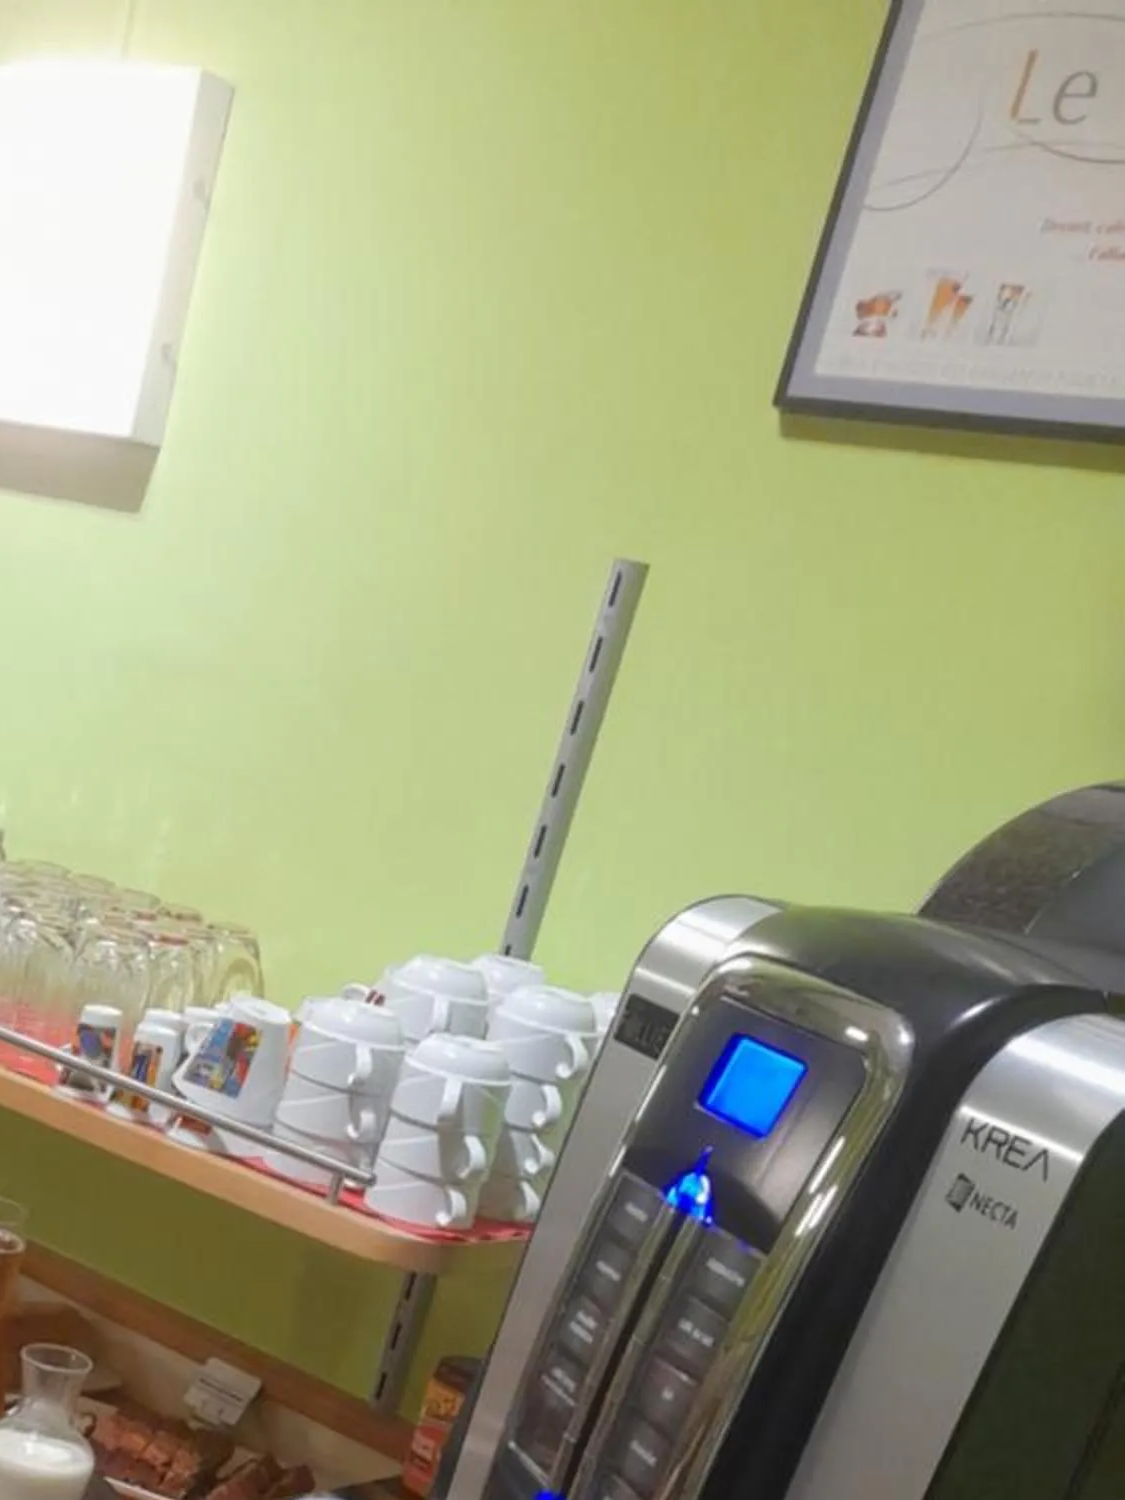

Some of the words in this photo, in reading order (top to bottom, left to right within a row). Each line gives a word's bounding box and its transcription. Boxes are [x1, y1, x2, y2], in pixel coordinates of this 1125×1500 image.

[1010, 49, 1098, 125] Le
[960, 1117, 1049, 1183] KREA
[969, 1191, 1020, 1230] NECTA
